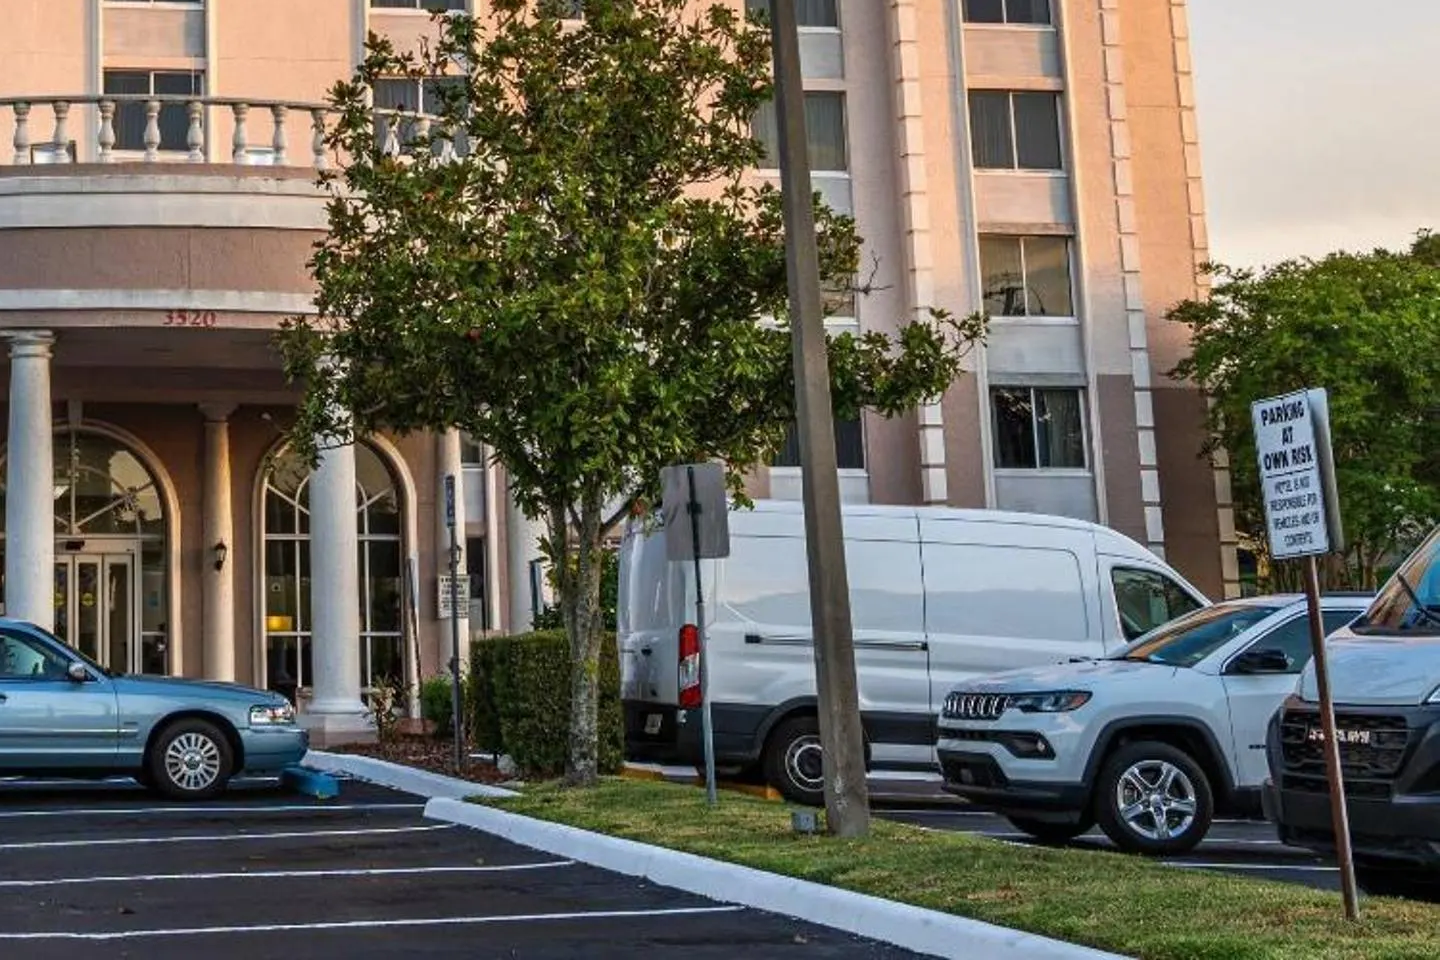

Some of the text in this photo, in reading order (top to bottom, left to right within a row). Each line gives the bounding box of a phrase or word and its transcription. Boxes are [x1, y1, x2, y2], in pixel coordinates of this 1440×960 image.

[1261, 401, 1304, 426] PARKING
[1282, 426, 1293, 445] AT
[1264, 444, 1314, 470] OWN RISK
